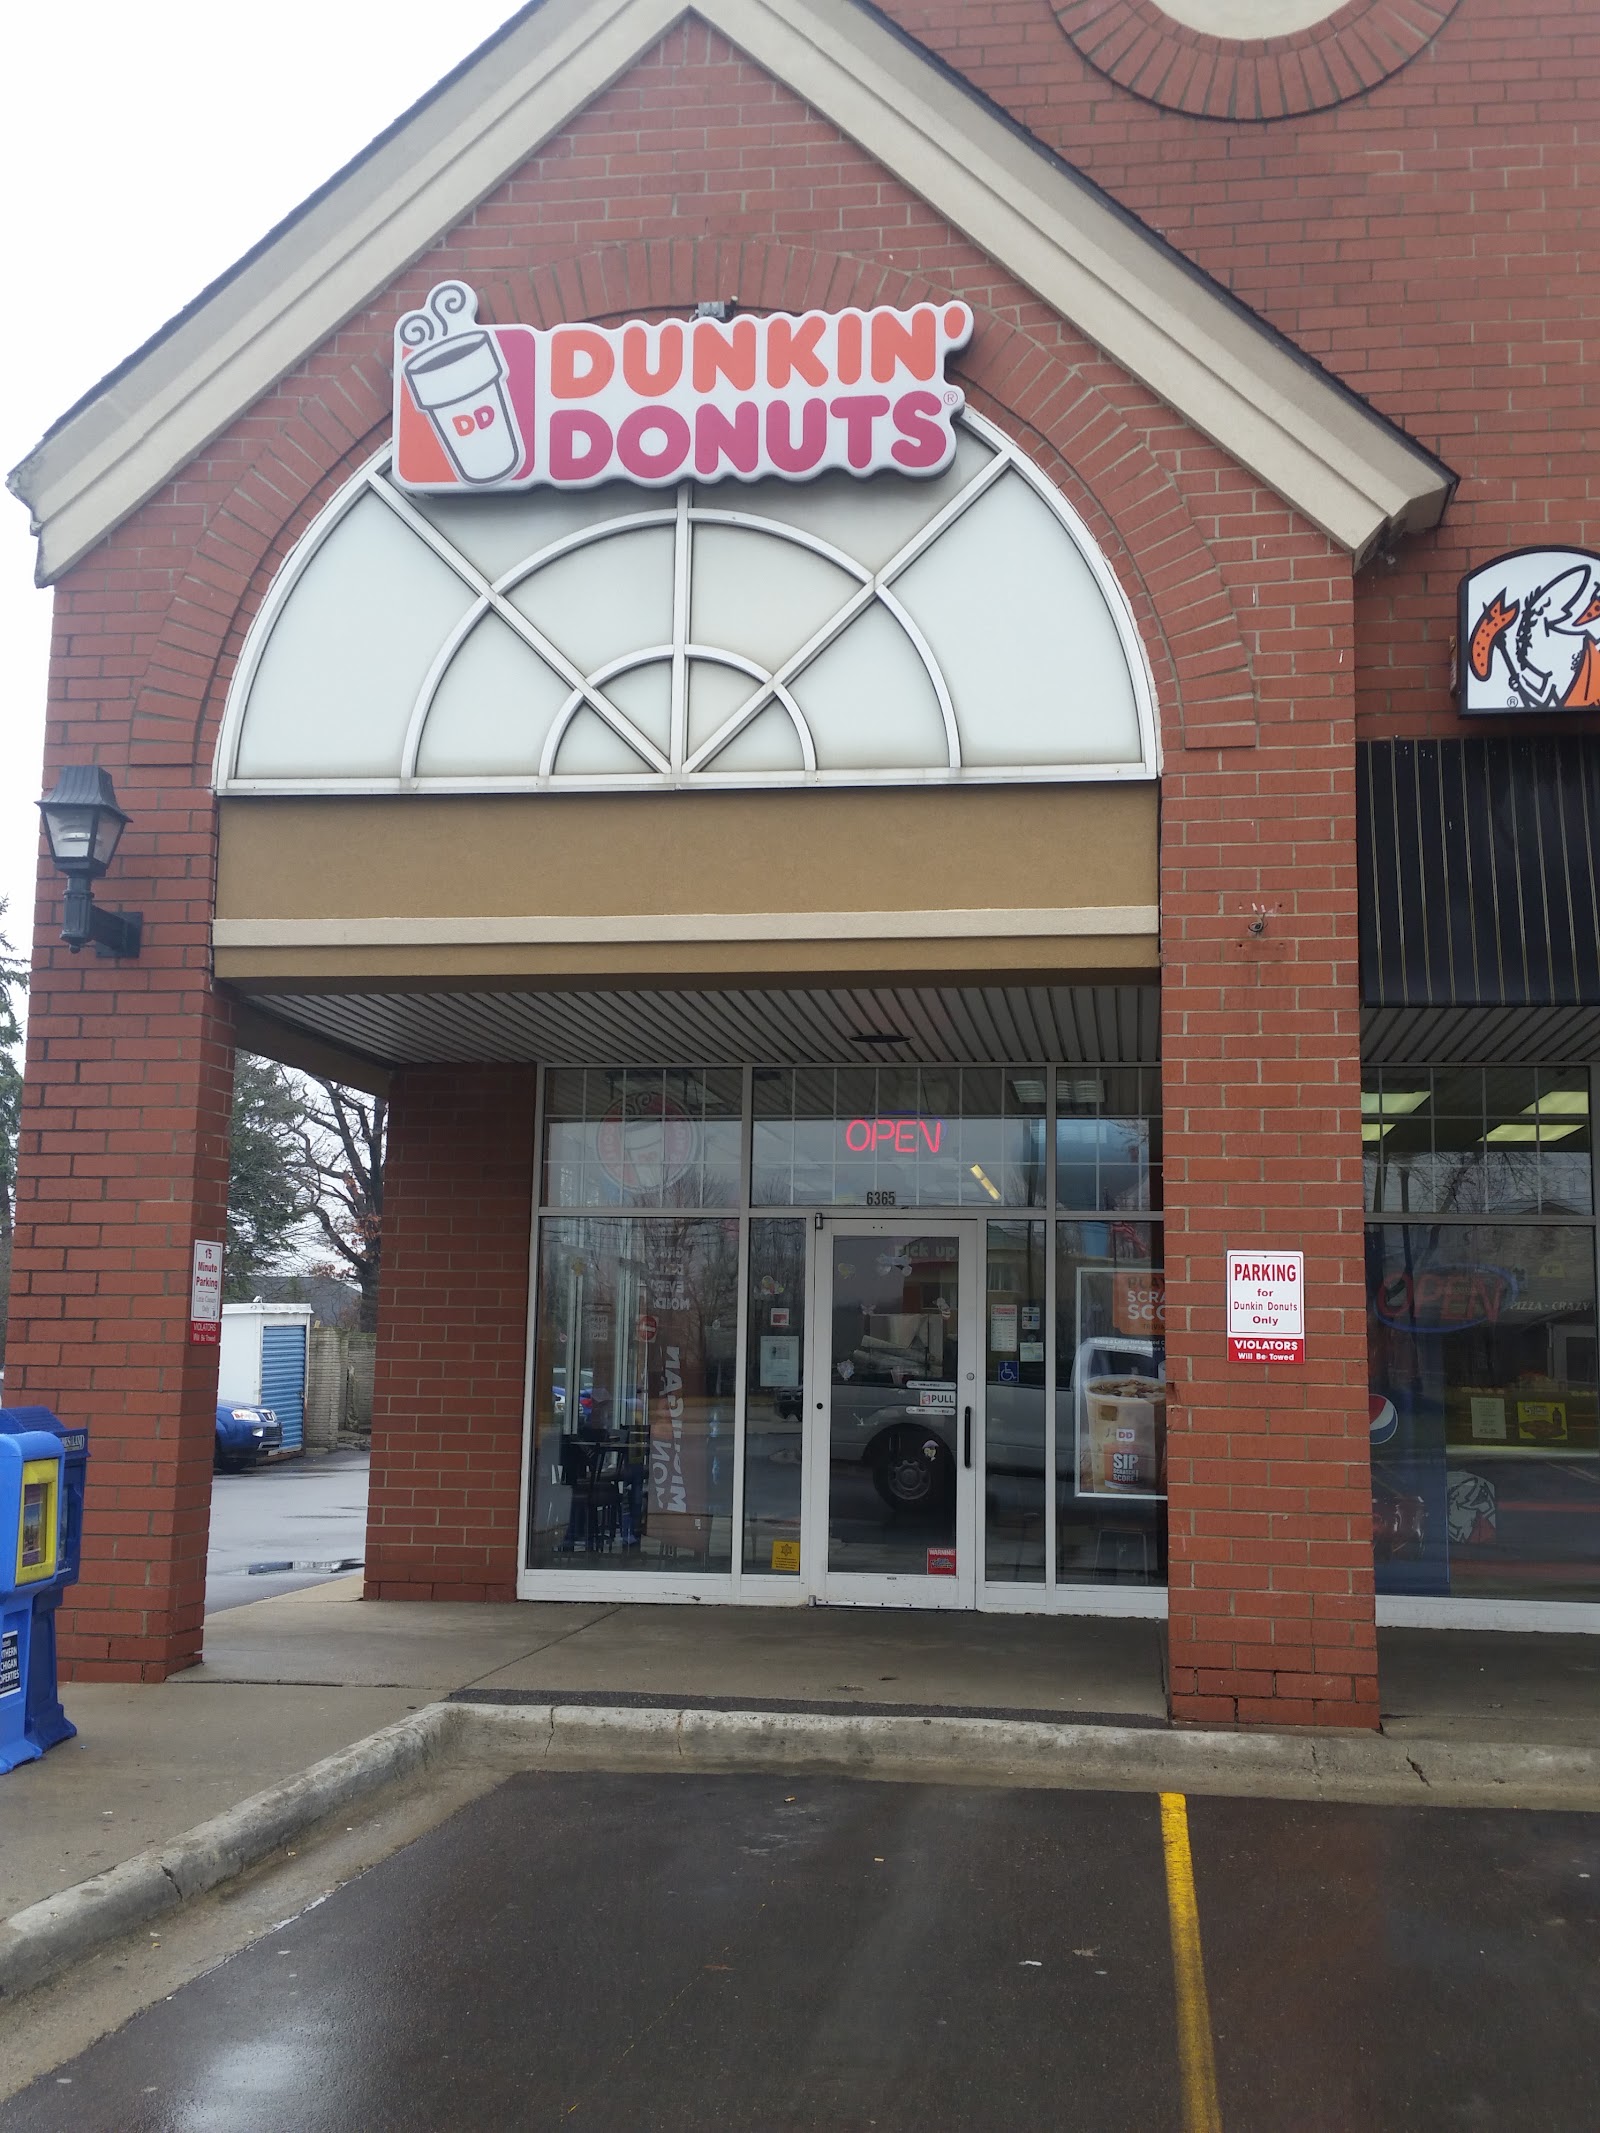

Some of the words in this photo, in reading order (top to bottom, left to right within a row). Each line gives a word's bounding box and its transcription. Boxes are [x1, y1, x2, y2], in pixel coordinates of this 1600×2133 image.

[551, 306, 967, 399] DUNKIN'
[452, 405, 495, 437] DD
[549, 391, 946, 481] DONUTS
[846, 1119, 942, 1153] OPEN
[866, 1191, 896, 1206] 6365
[205, 1247, 212, 1259] 15
[197, 1261, 218, 1273] Minute
[1234, 1263, 1297, 1282] PARKING
[195, 1276, 218, 1290] Parking
[1257, 1288, 1274, 1297] for
[1377, 1271, 1503, 1321] OPEN
[1233, 1301, 1264, 1311] Dunkin
[1267, 1302, 1298, 1312] Donuts
[1252, 1315, 1279, 1326] Only
[193, 1322, 217, 1332] VIOLATORS
[1234, 1340, 1298, 1351] VIOLATORS
[1238, 1352, 1253, 1360] Will
[1256, 1352, 1266, 1360] Be
[1269, 1353, 1295, 1361] Towed
[931, 1394, 954, 1403] PULL
[1118, 1431, 1133, 1439] DD
[1113, 1453, 1139, 1469] SIP
